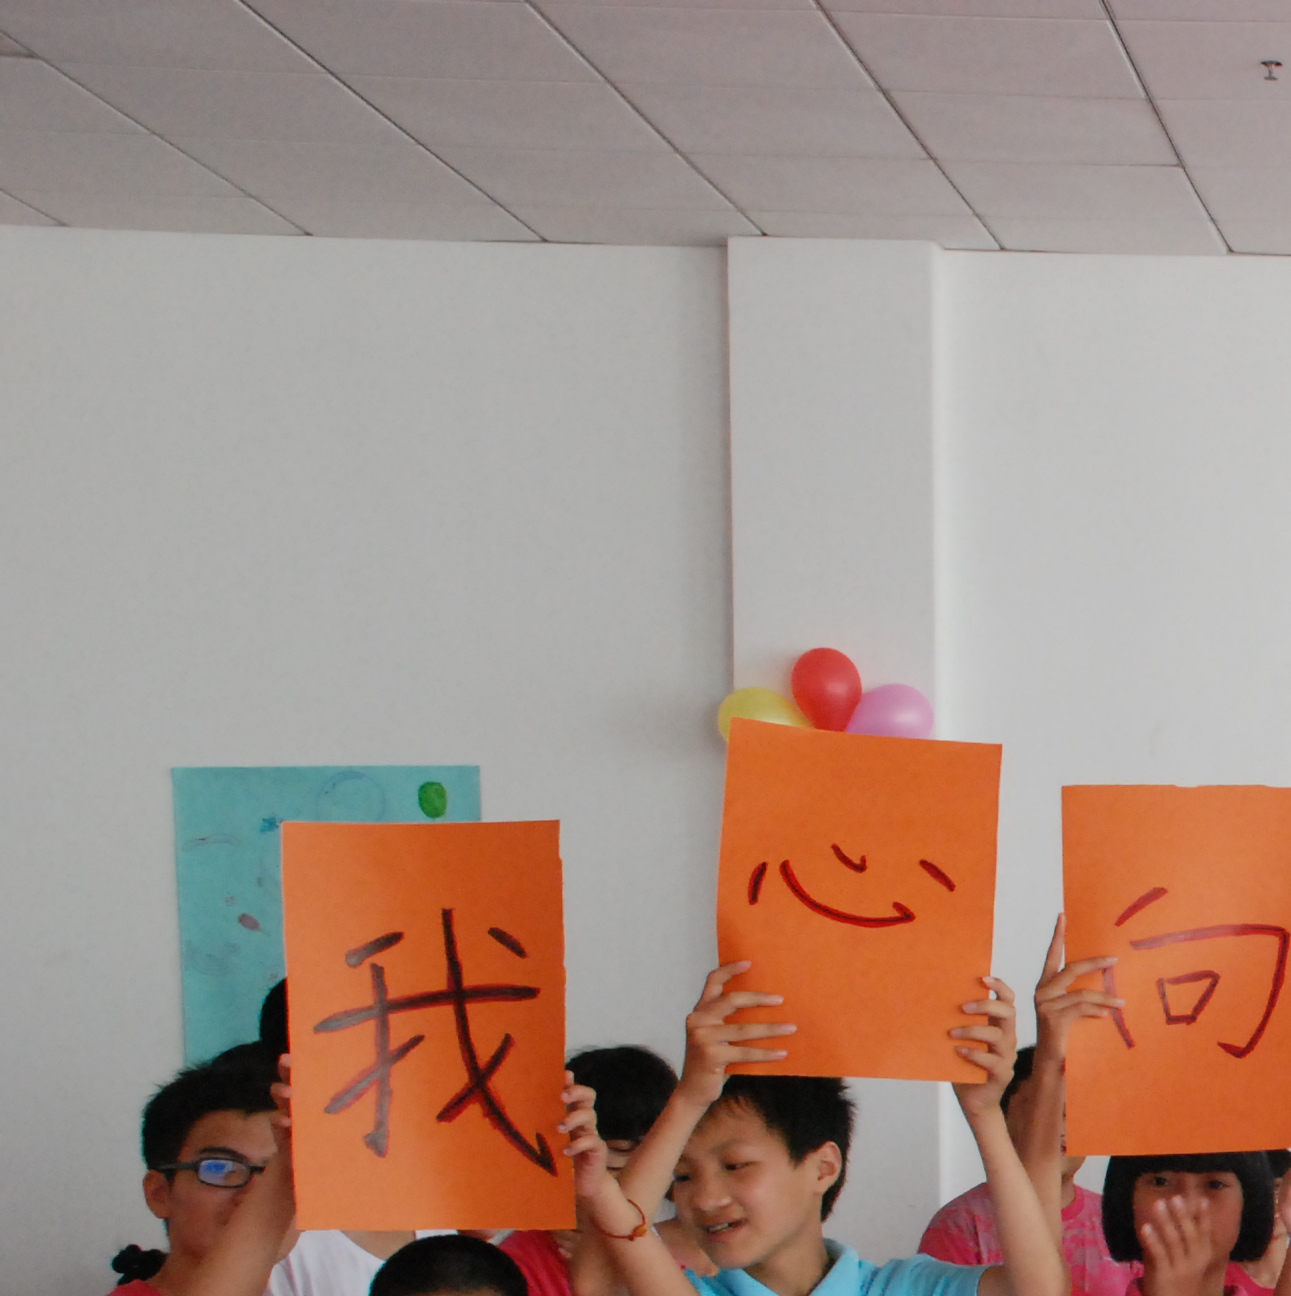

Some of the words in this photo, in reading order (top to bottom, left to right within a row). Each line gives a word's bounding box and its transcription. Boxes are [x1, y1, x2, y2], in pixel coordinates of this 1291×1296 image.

[747, 843, 956, 928] 心
[313, 907, 558, 1177] 我
[1102, 886, 1291, 1059] 向
